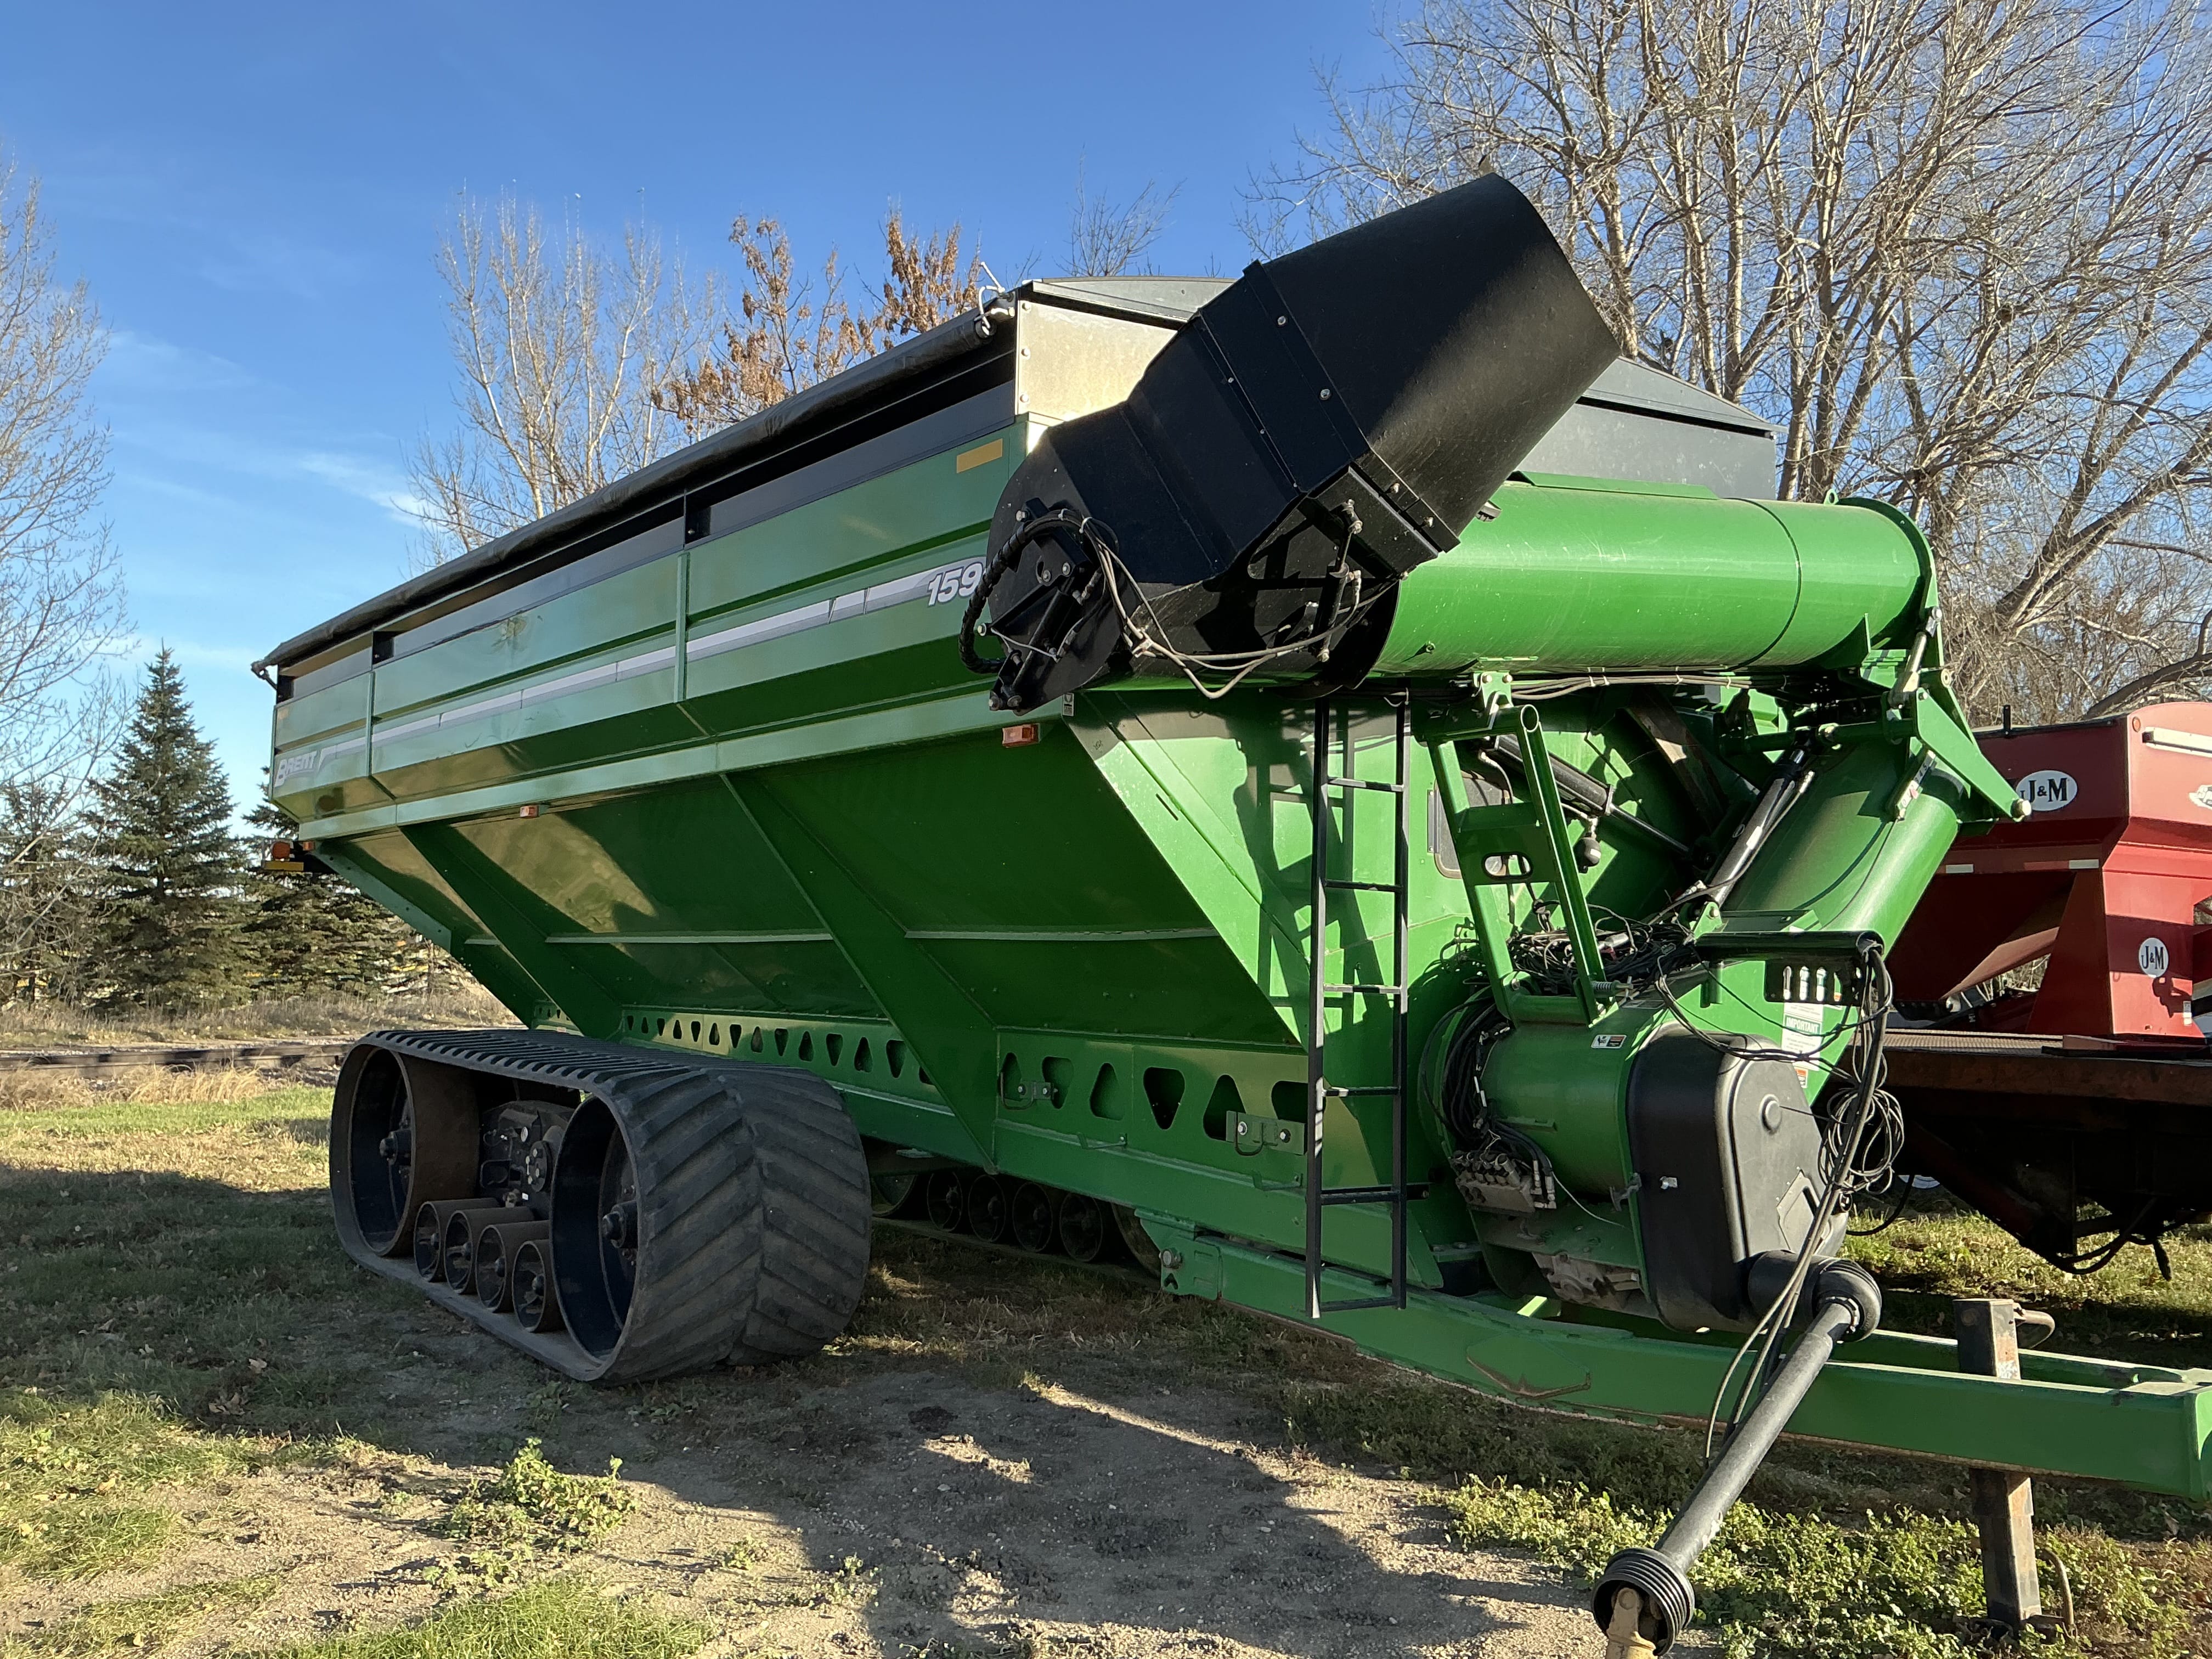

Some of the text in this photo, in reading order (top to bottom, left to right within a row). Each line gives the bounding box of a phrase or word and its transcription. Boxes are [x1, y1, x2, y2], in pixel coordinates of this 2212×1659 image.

[927, 562, 986, 607] 159
[274, 751, 318, 787] BRENT
[2019, 777, 2068, 803] J&M
[2141, 946, 2164, 970] J&M
[1786, 1017, 1819, 1034] IMPORTANT
